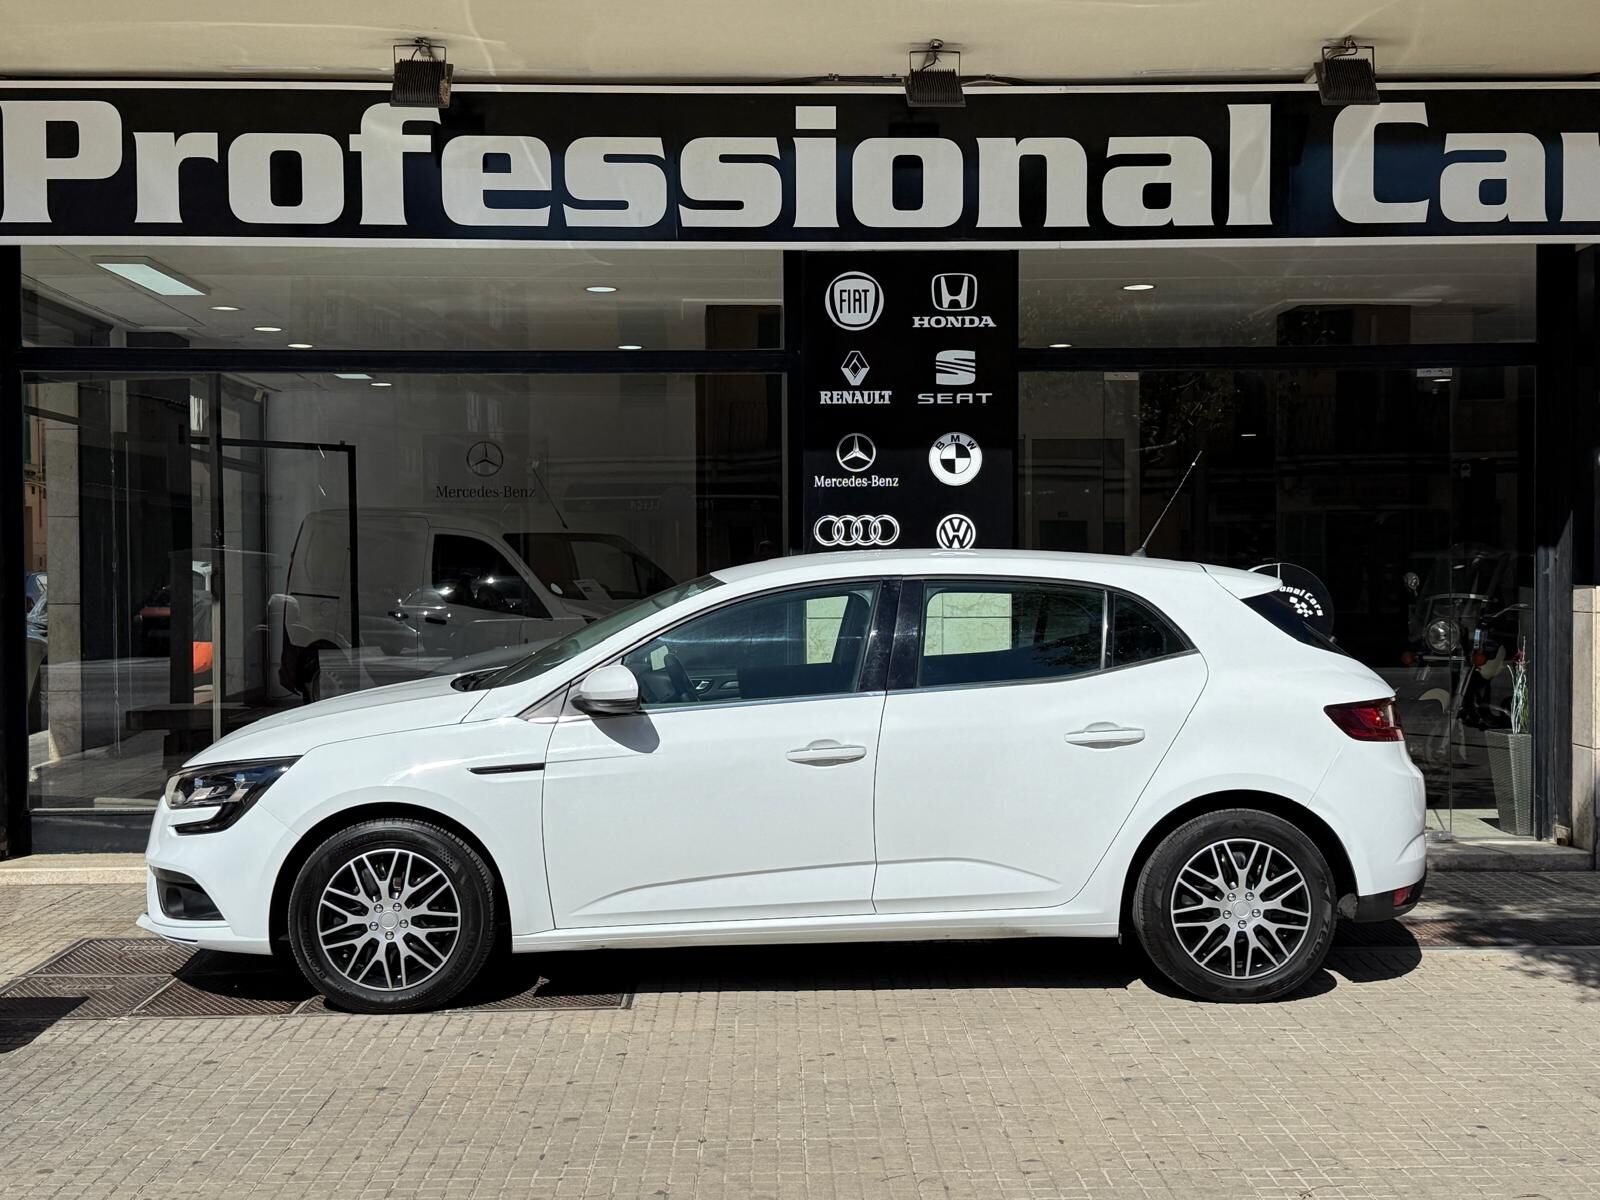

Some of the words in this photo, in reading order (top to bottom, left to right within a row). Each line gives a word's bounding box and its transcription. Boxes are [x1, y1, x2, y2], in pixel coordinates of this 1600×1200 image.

[0, 101, 1272, 228] Professional
[839, 289, 870, 314] FIAT
[912, 315, 997, 328] HONDA
[819, 390, 893, 405] RENAULT
[917, 392, 993, 404] SEAT
[935, 434, 977, 451] BMW
[813, 474, 899, 488] Mercedes-Benz
[435, 485, 537, 499] Mercedes-Benz
